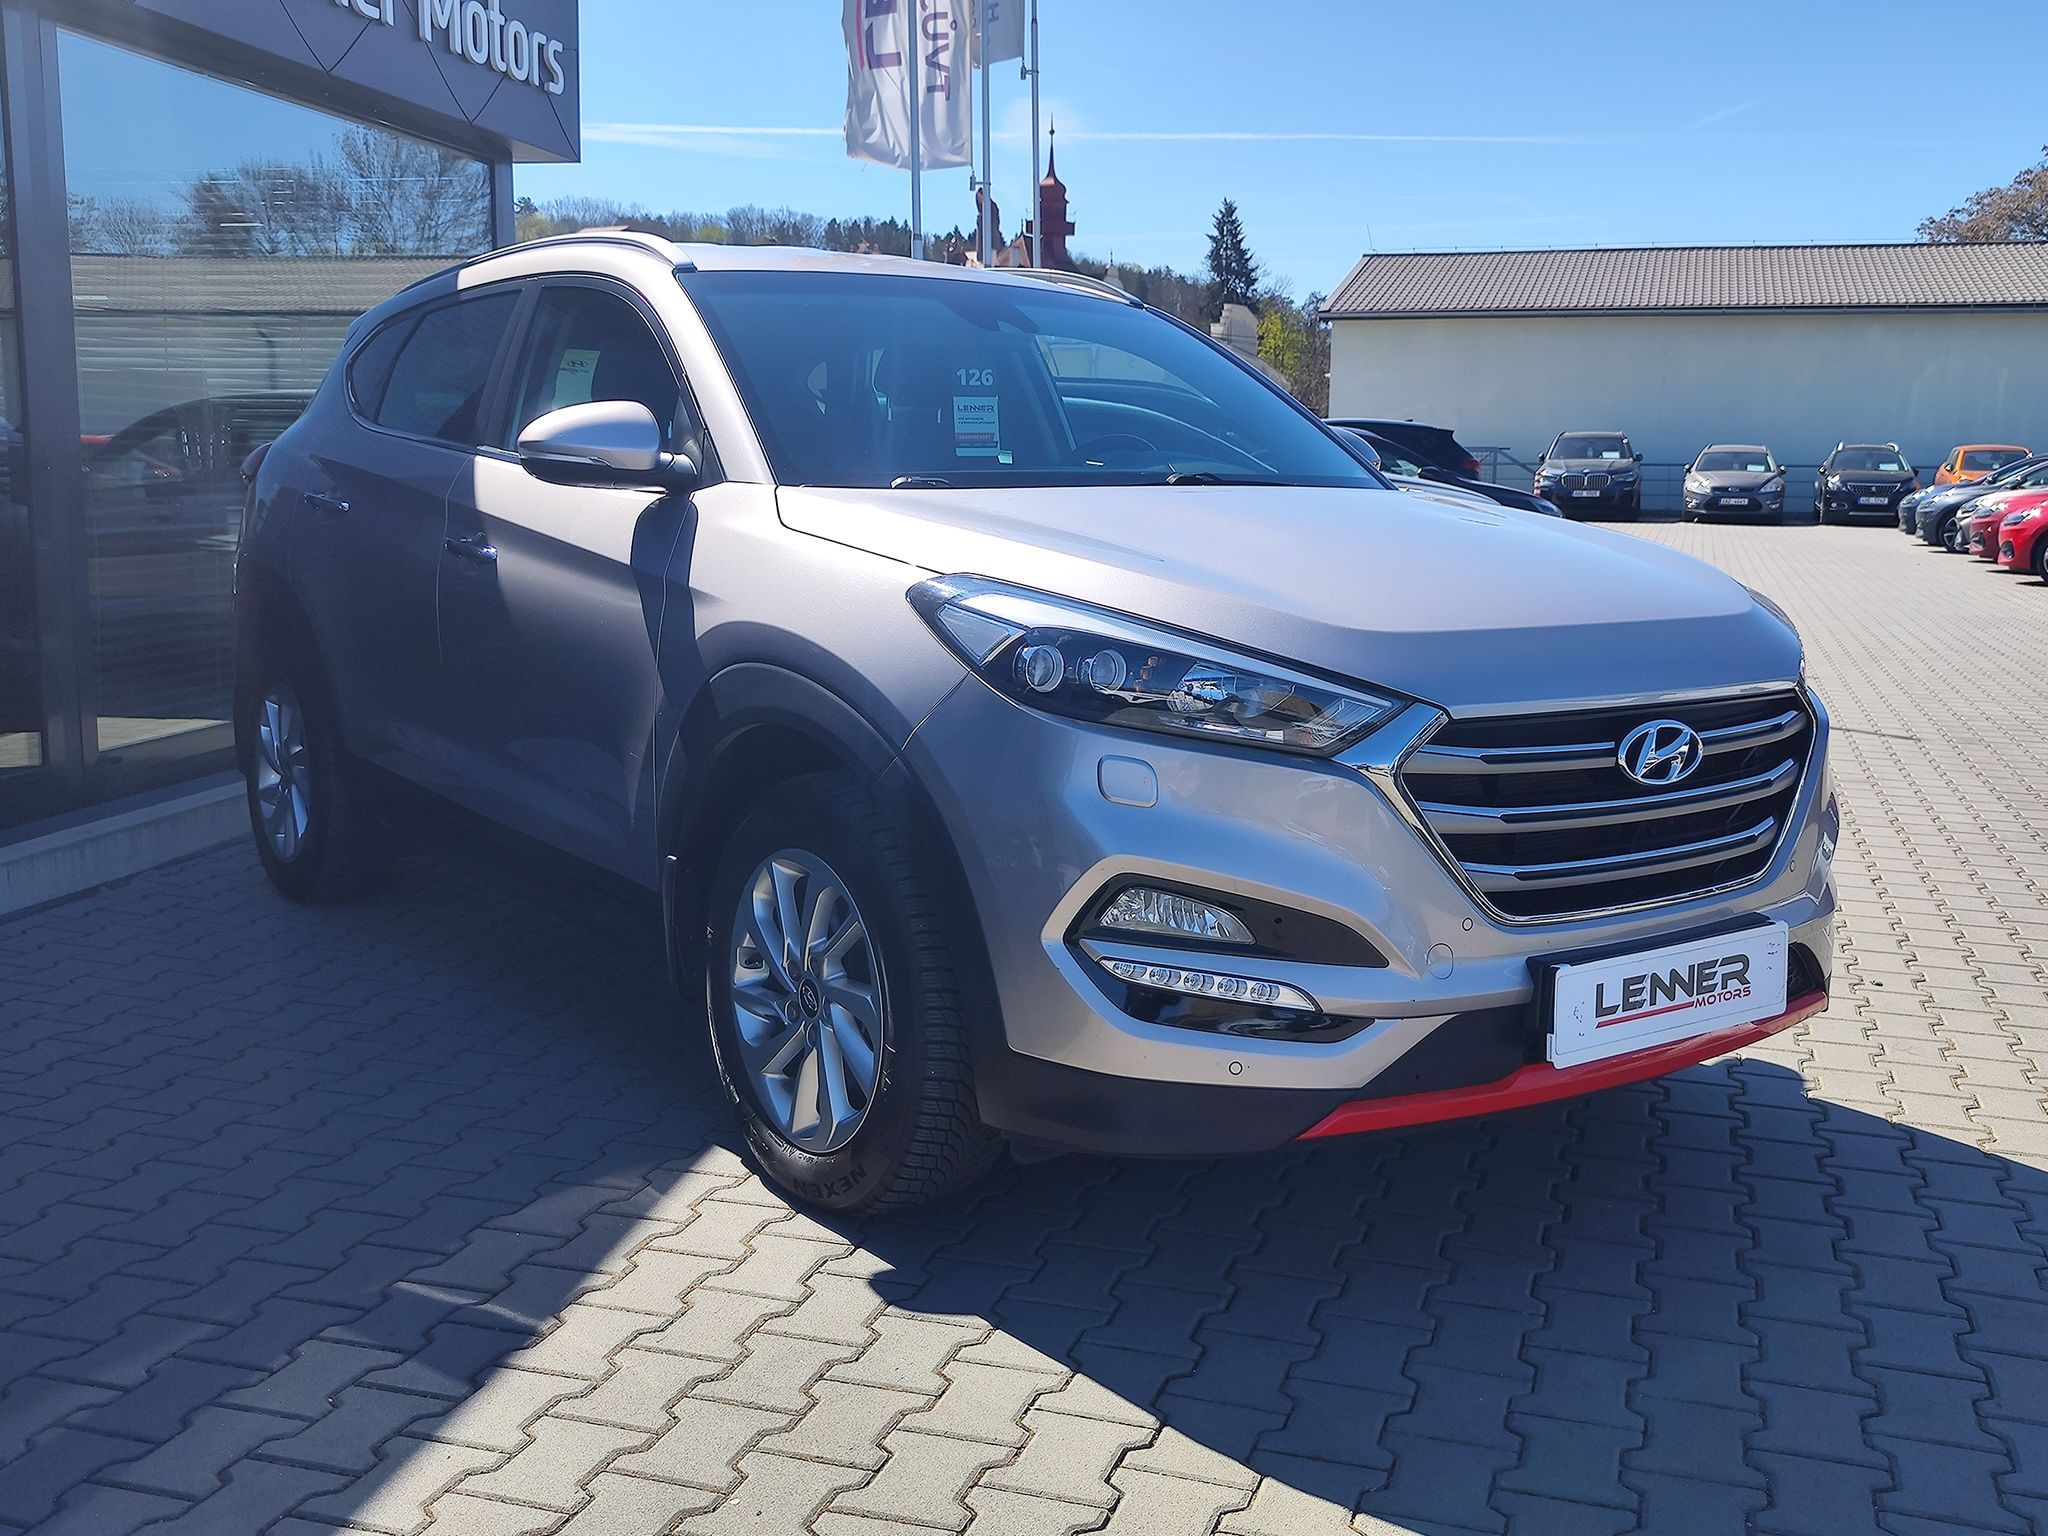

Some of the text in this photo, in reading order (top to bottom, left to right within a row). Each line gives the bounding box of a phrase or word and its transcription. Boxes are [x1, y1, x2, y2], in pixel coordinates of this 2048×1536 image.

[417, 0, 565, 96] Motors
[956, 368, 994, 386] 126
[1595, 953, 1751, 1019] LENNER
[1694, 986, 1752, 1009] MOTORS
[792, 1163, 867, 1199] NEXEN
